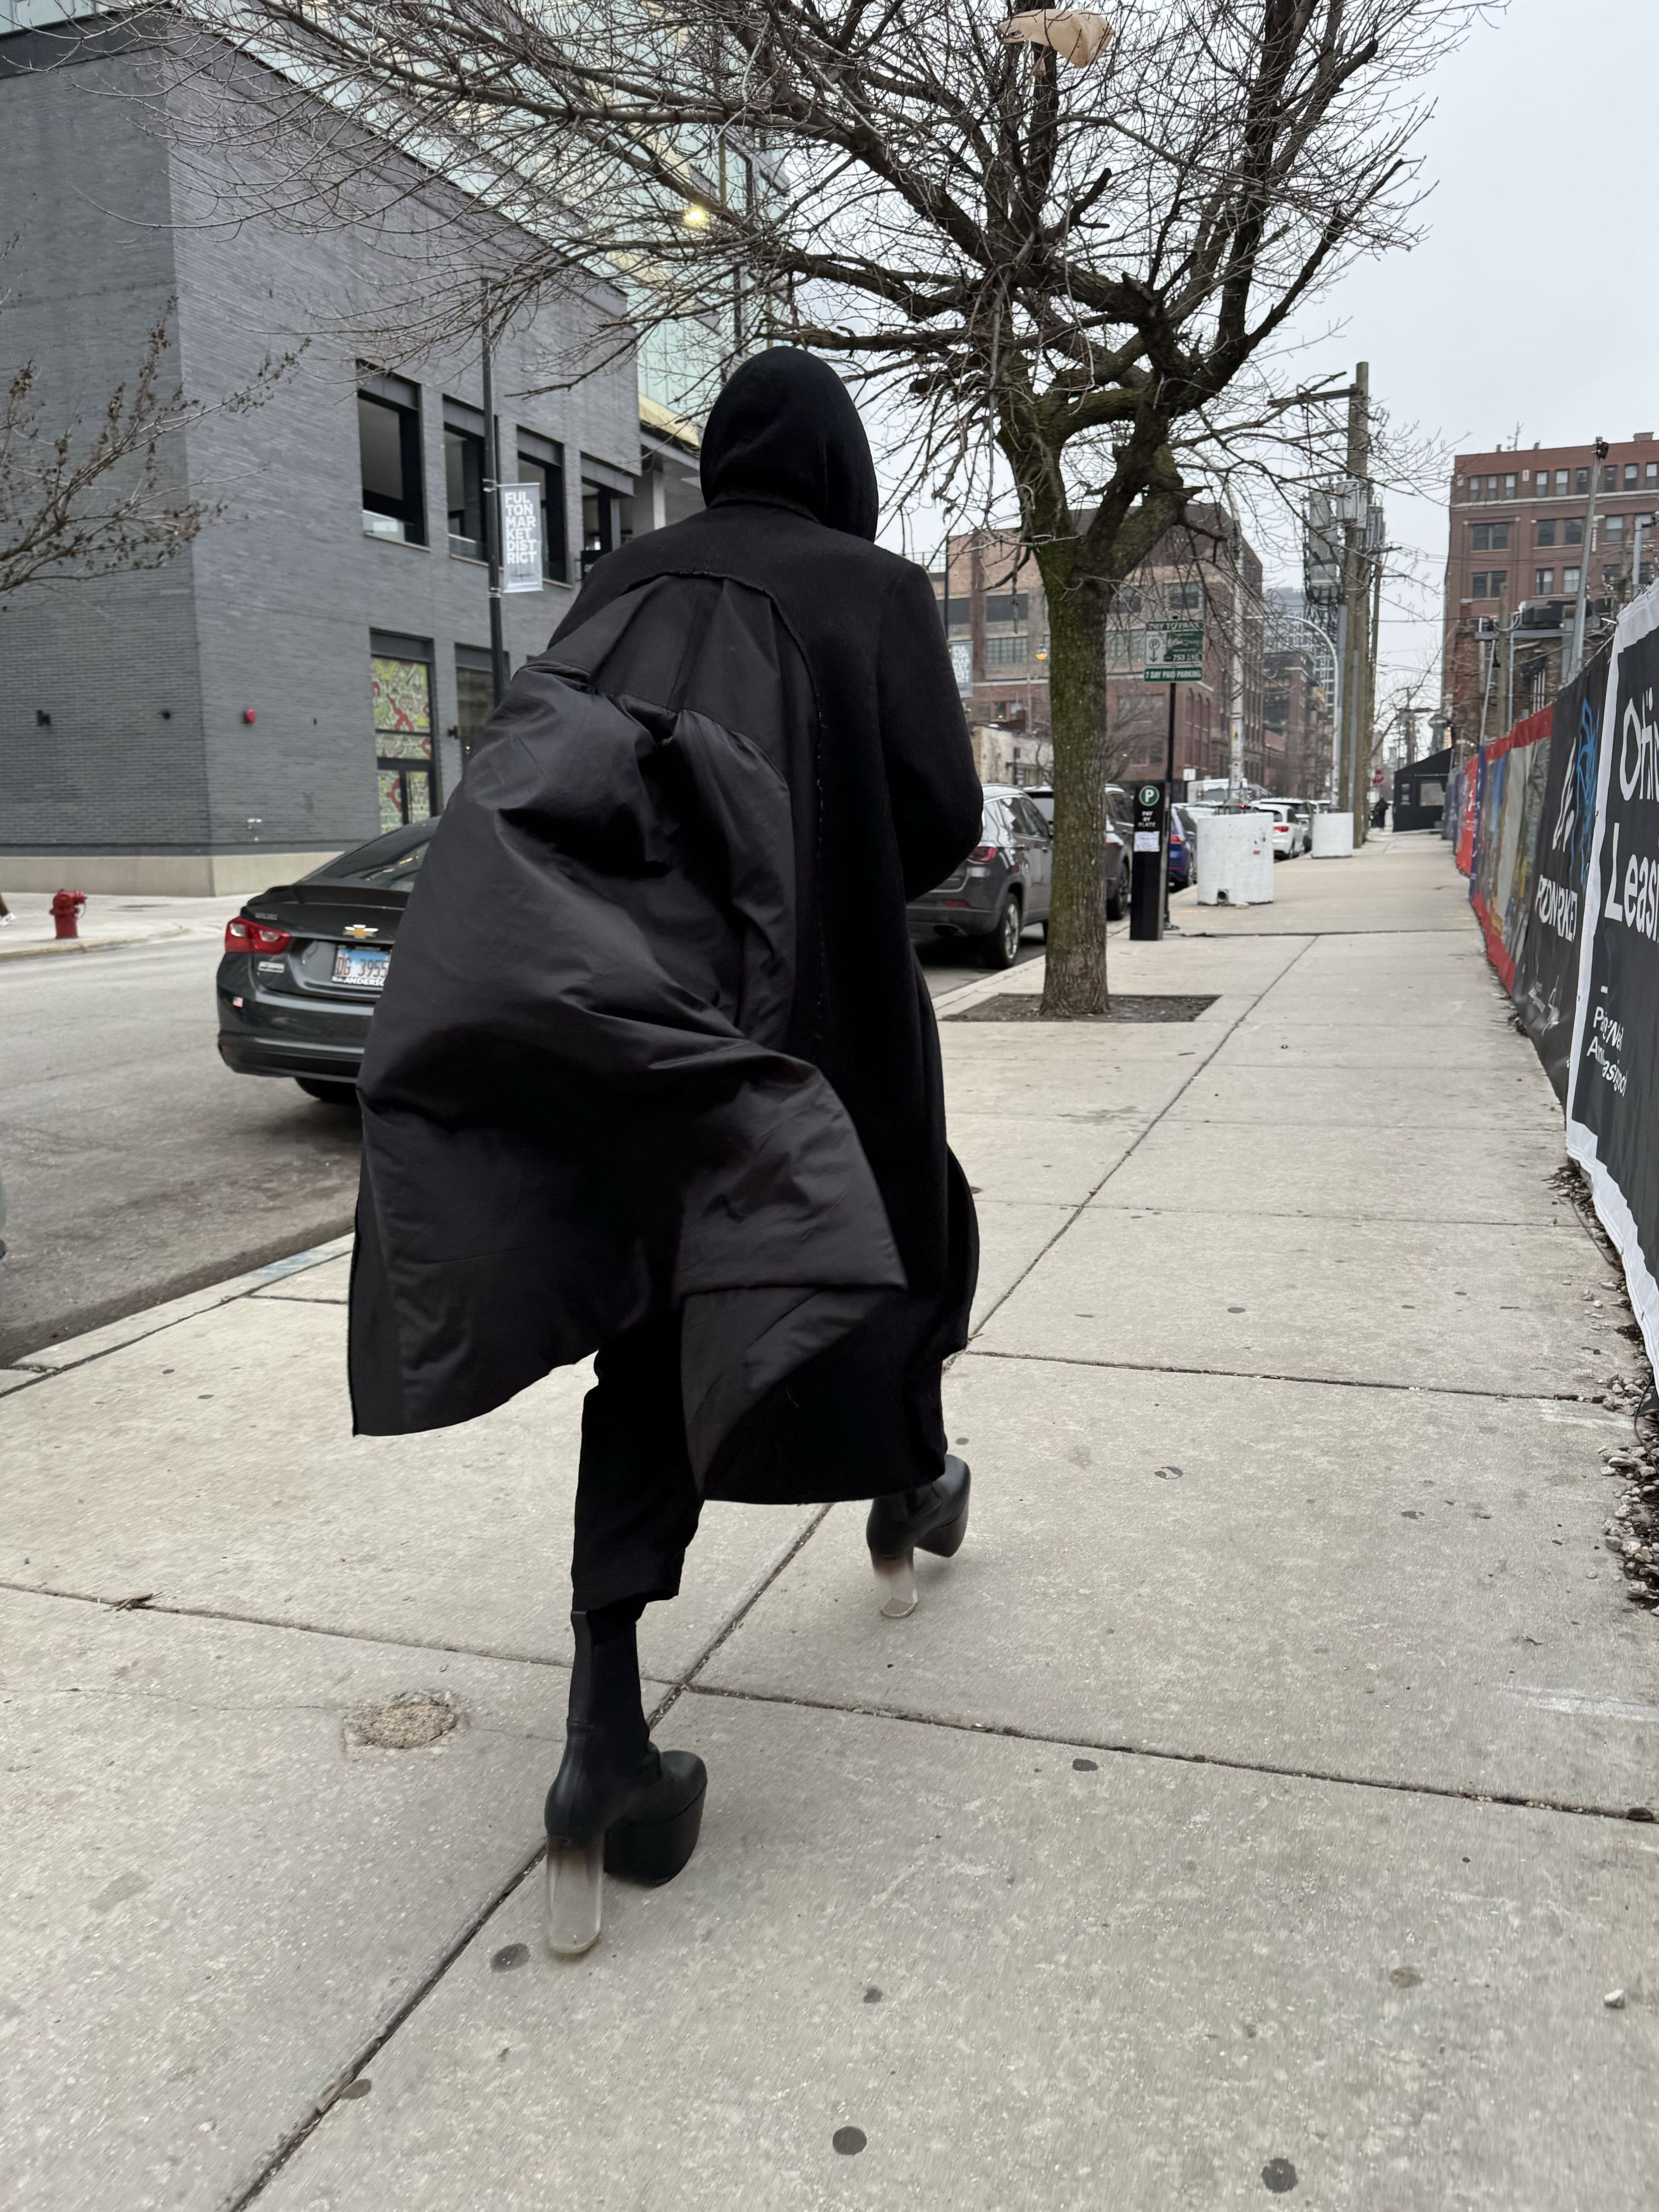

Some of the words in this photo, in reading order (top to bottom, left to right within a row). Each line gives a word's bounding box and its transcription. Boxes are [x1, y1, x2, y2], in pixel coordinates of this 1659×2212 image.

[505, 491, 531, 504] FUL
[506, 504, 533, 516] TON
[506, 516, 537, 528] MAR
[506, 528, 532, 540] KET
[507, 539, 536, 552] DIST
[507, 551, 537, 564] RICT
[1604, 822, 1659, 943] Leasi
